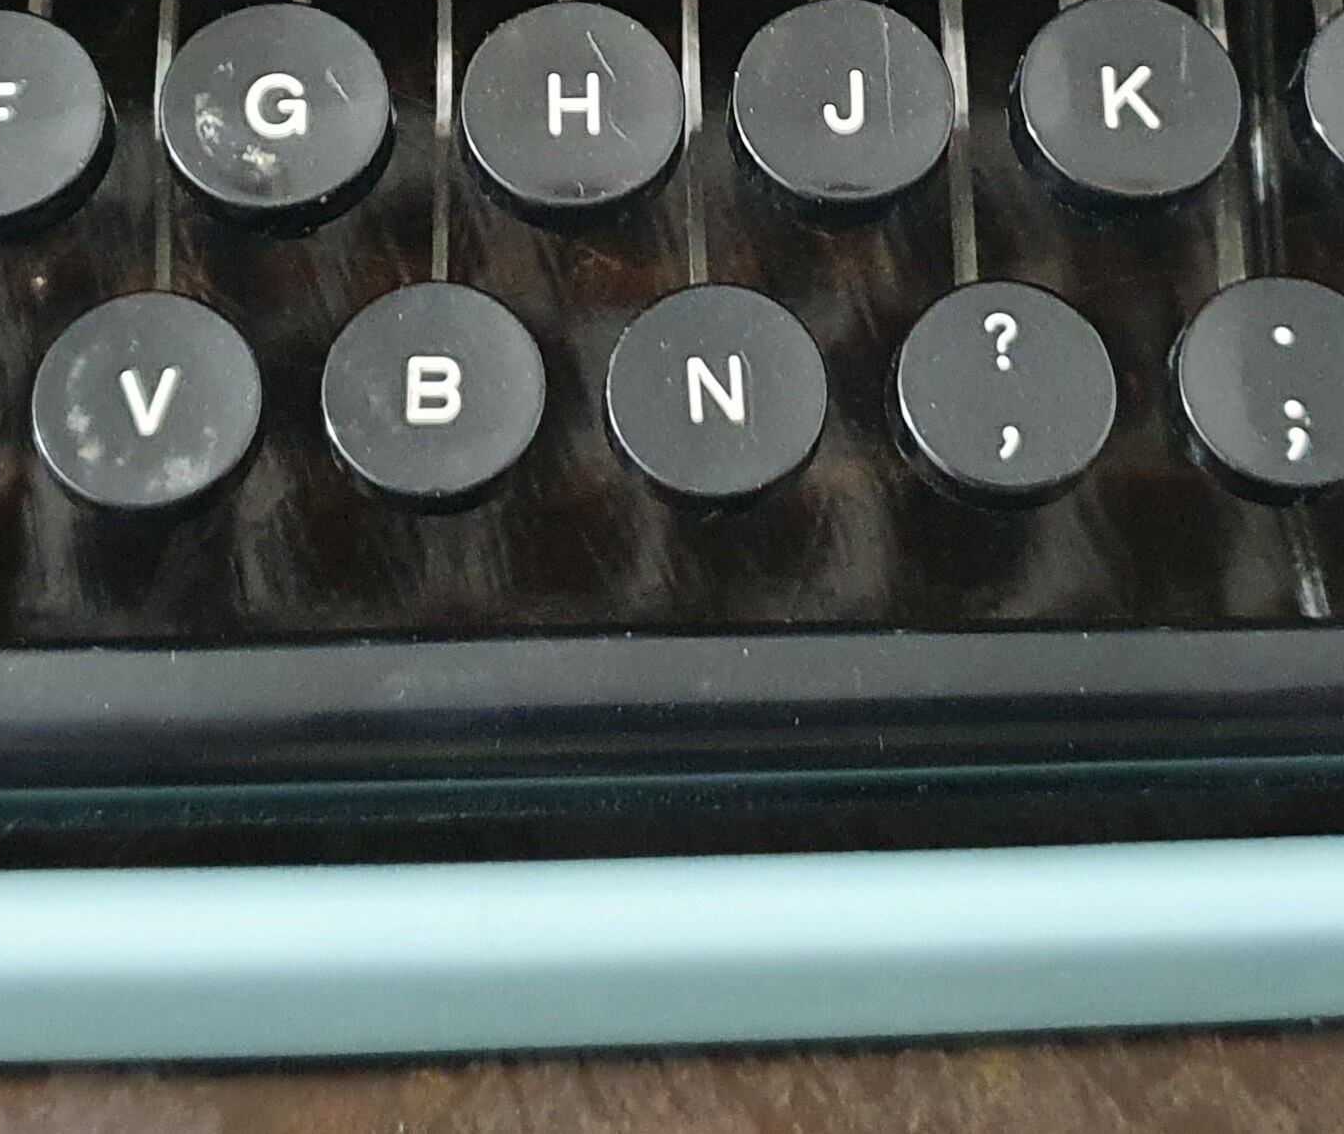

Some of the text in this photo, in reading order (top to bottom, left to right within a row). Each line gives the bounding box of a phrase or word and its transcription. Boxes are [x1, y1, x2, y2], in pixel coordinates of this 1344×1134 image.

[245, 73, 308, 139] G
[547, 72, 601, 136] H
[823, 69, 864, 135] J
[1101, 65, 1161, 130] K
[984, 312, 1017, 371] ?
[120, 367, 177, 436] V
[406, 356, 462, 424] B
[687, 354, 745, 424] N
